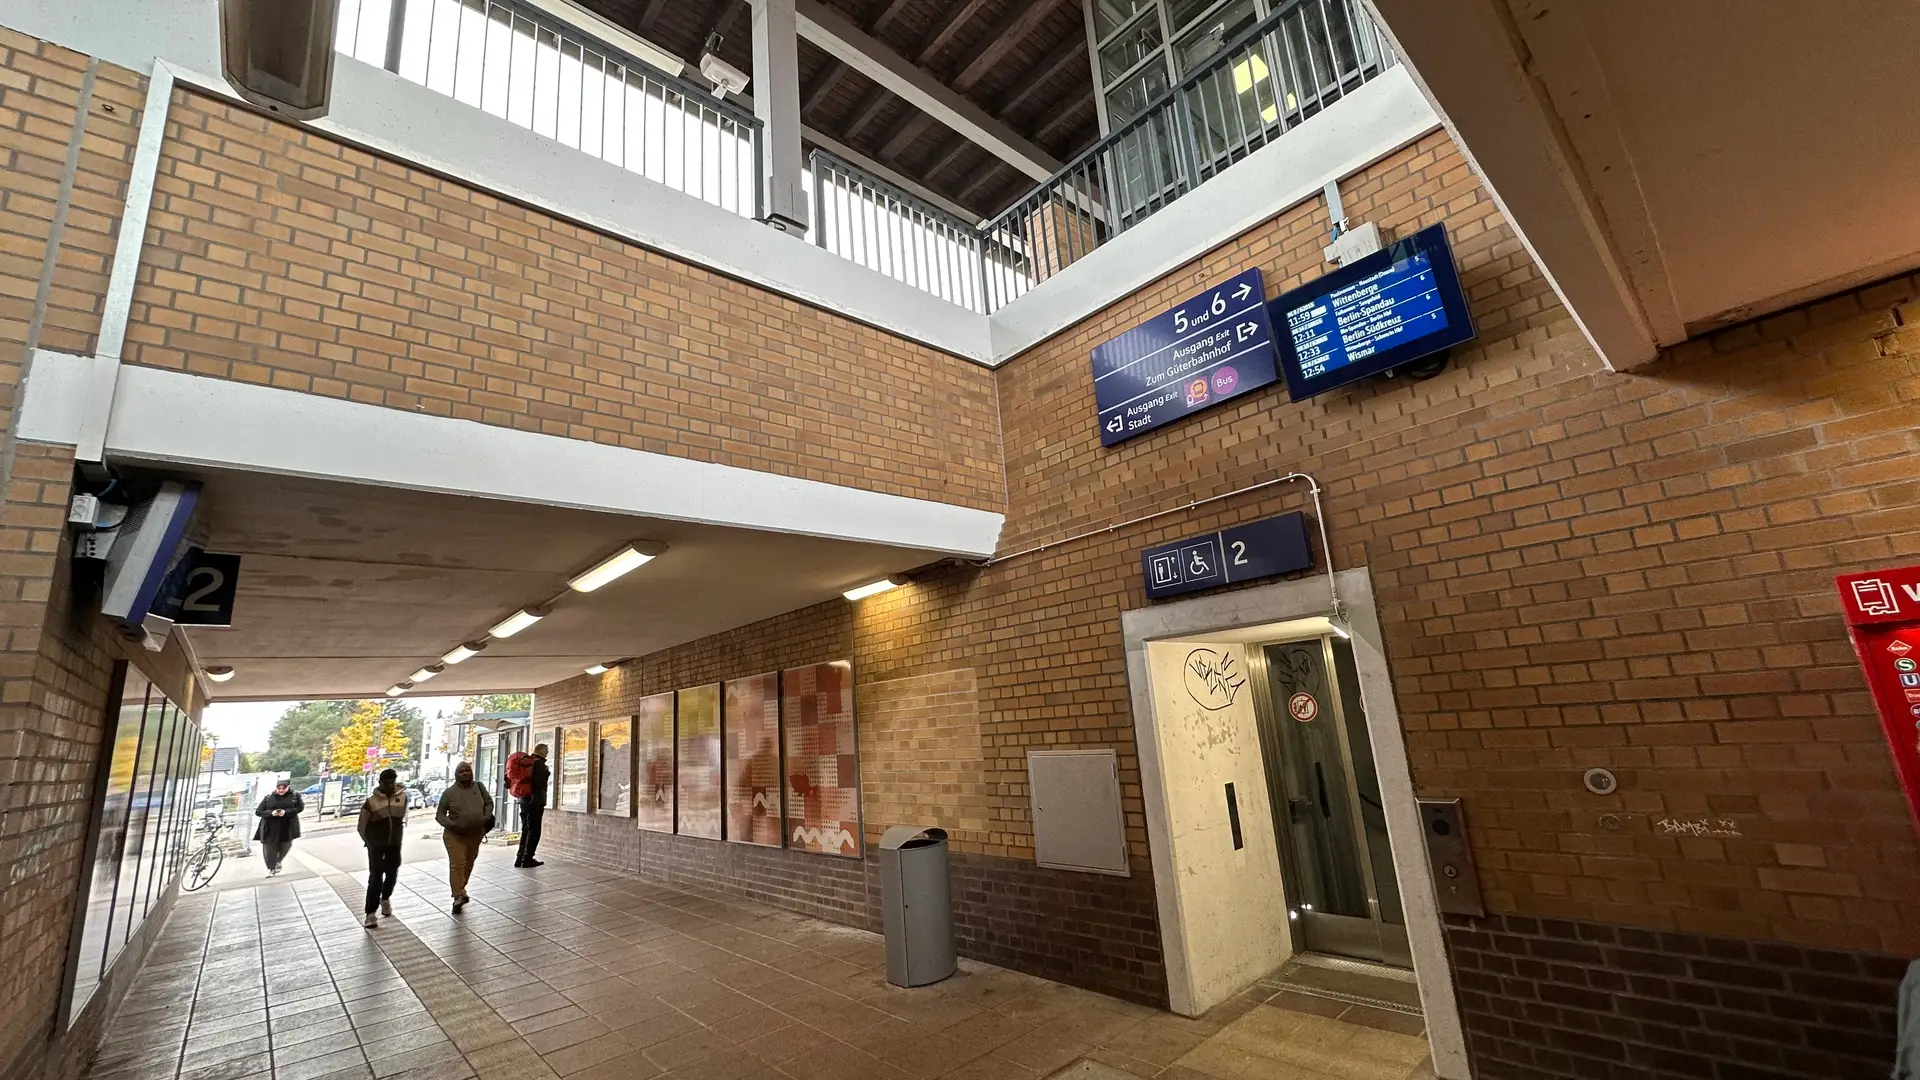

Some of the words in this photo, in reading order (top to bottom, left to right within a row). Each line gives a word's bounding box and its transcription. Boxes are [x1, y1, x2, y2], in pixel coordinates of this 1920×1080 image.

[1174, 309, 1189, 334] 5
[1191, 312, 1210, 327] und
[1211, 291, 1227, 316] 6
[1288, 311, 1311, 327] 11:59
[1331, 284, 1379, 308] Wittenberge
[1293, 329, 1316, 344] 12:11
[1337, 297, 1395, 326] Berlin-Spandau
[1173, 335, 1214, 360] Ausgang
[1215, 329, 1231, 342] Exit
[1298, 346, 1321, 361] 12:33
[1342, 330, 1366, 344] Berlin
[1365, 315, 1402, 335] Südkreuz
[1145, 372, 1166, 387] Zum
[1166, 340, 1233, 377] Güterbahnhof
[1302, 363, 1326, 378] 12:54
[1347, 346, 1375, 361] Wismar
[1127, 395, 1164, 418] Ausgang
[1165, 391, 1179, 402] Exit
[1216, 374, 1233, 388] Bus
[1128, 414, 1152, 431] Stadt
[1230, 540, 1248, 566] 2
[182, 566, 224, 611] 2
[1898, 659, 1913, 671] S
[1902, 675, 1918, 685] U
